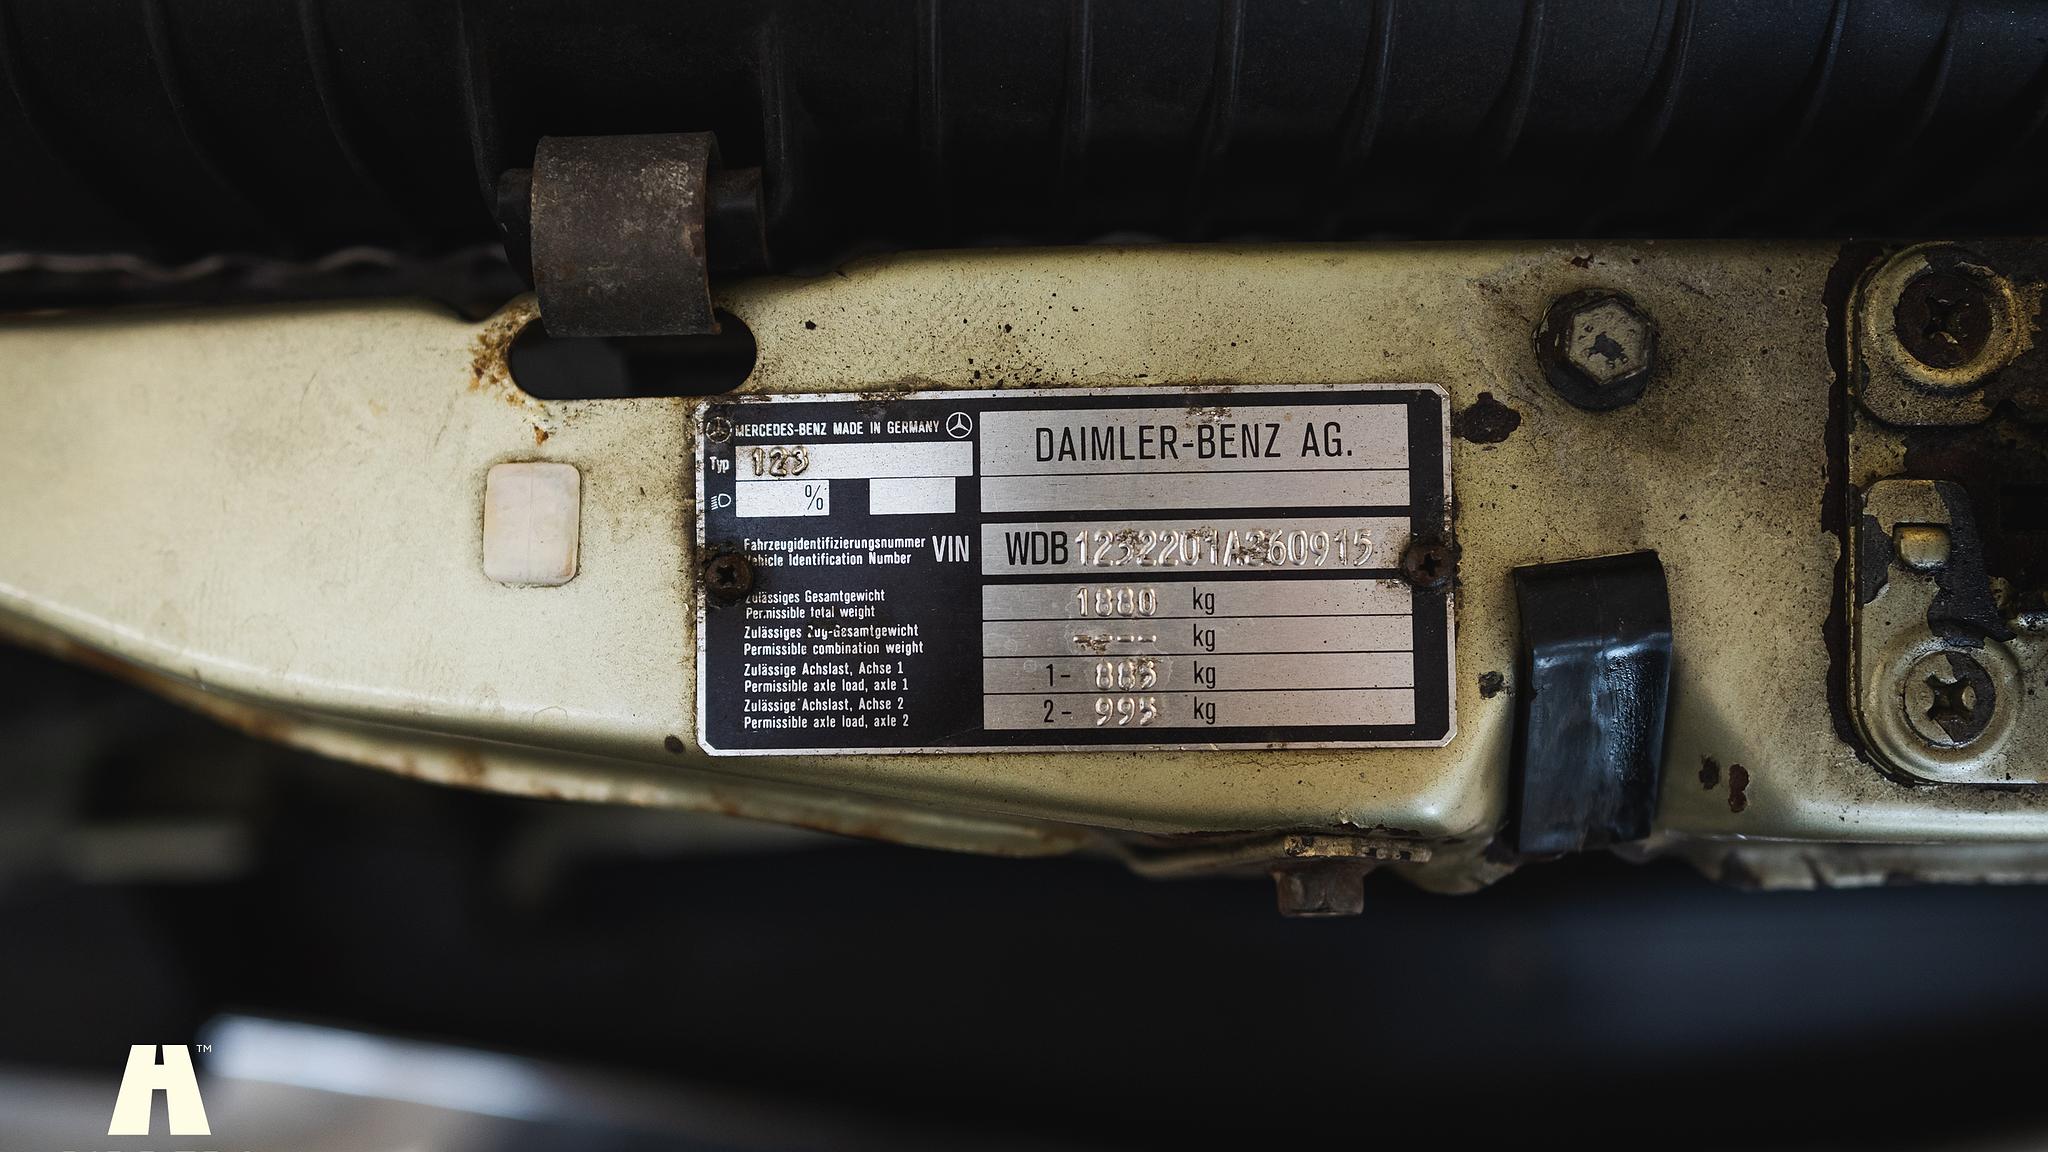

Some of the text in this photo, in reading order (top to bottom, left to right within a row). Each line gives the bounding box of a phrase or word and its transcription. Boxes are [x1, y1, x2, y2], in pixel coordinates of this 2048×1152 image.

[735, 421, 939, 437] MERCEDES-BENZ MADE IN GERMANY
[1036, 422, 1353, 462] DAIMLER-BENZ AG.
[710, 456, 729, 474] Typ
[752, 447, 809, 476] 123
[805, 485, 824, 511] %
[744, 537, 925, 552] Fahrzeugidentifizierungsnummer
[932, 535, 969, 563] VIN
[789, 552, 863, 566] Identification
[869, 551, 911, 565] Number
[805, 589, 885, 603] Gesamtgewicht
[1077, 587, 1215, 617] 1880 kg
[746, 605, 875, 619] Permissible total weight
[744, 625, 801, 639] Zulässiges
[1193, 624, 1215, 651] kg
[744, 642, 923, 656] Permissible combination weight
[744, 661, 903, 677] Zulässige Achslast, Achse 1
[1095, 661, 1157, 690] 885
[1193, 661, 1216, 688] kg
[744, 678, 908, 693] Permissible axle load, axle 1
[744, 697, 904, 712] Zulässige Achslast, Achse 2
[1095, 697, 1157, 726] 995
[1193, 696, 1216, 724] kg
[744, 714, 909, 729] Permissible axle load, axle 2
